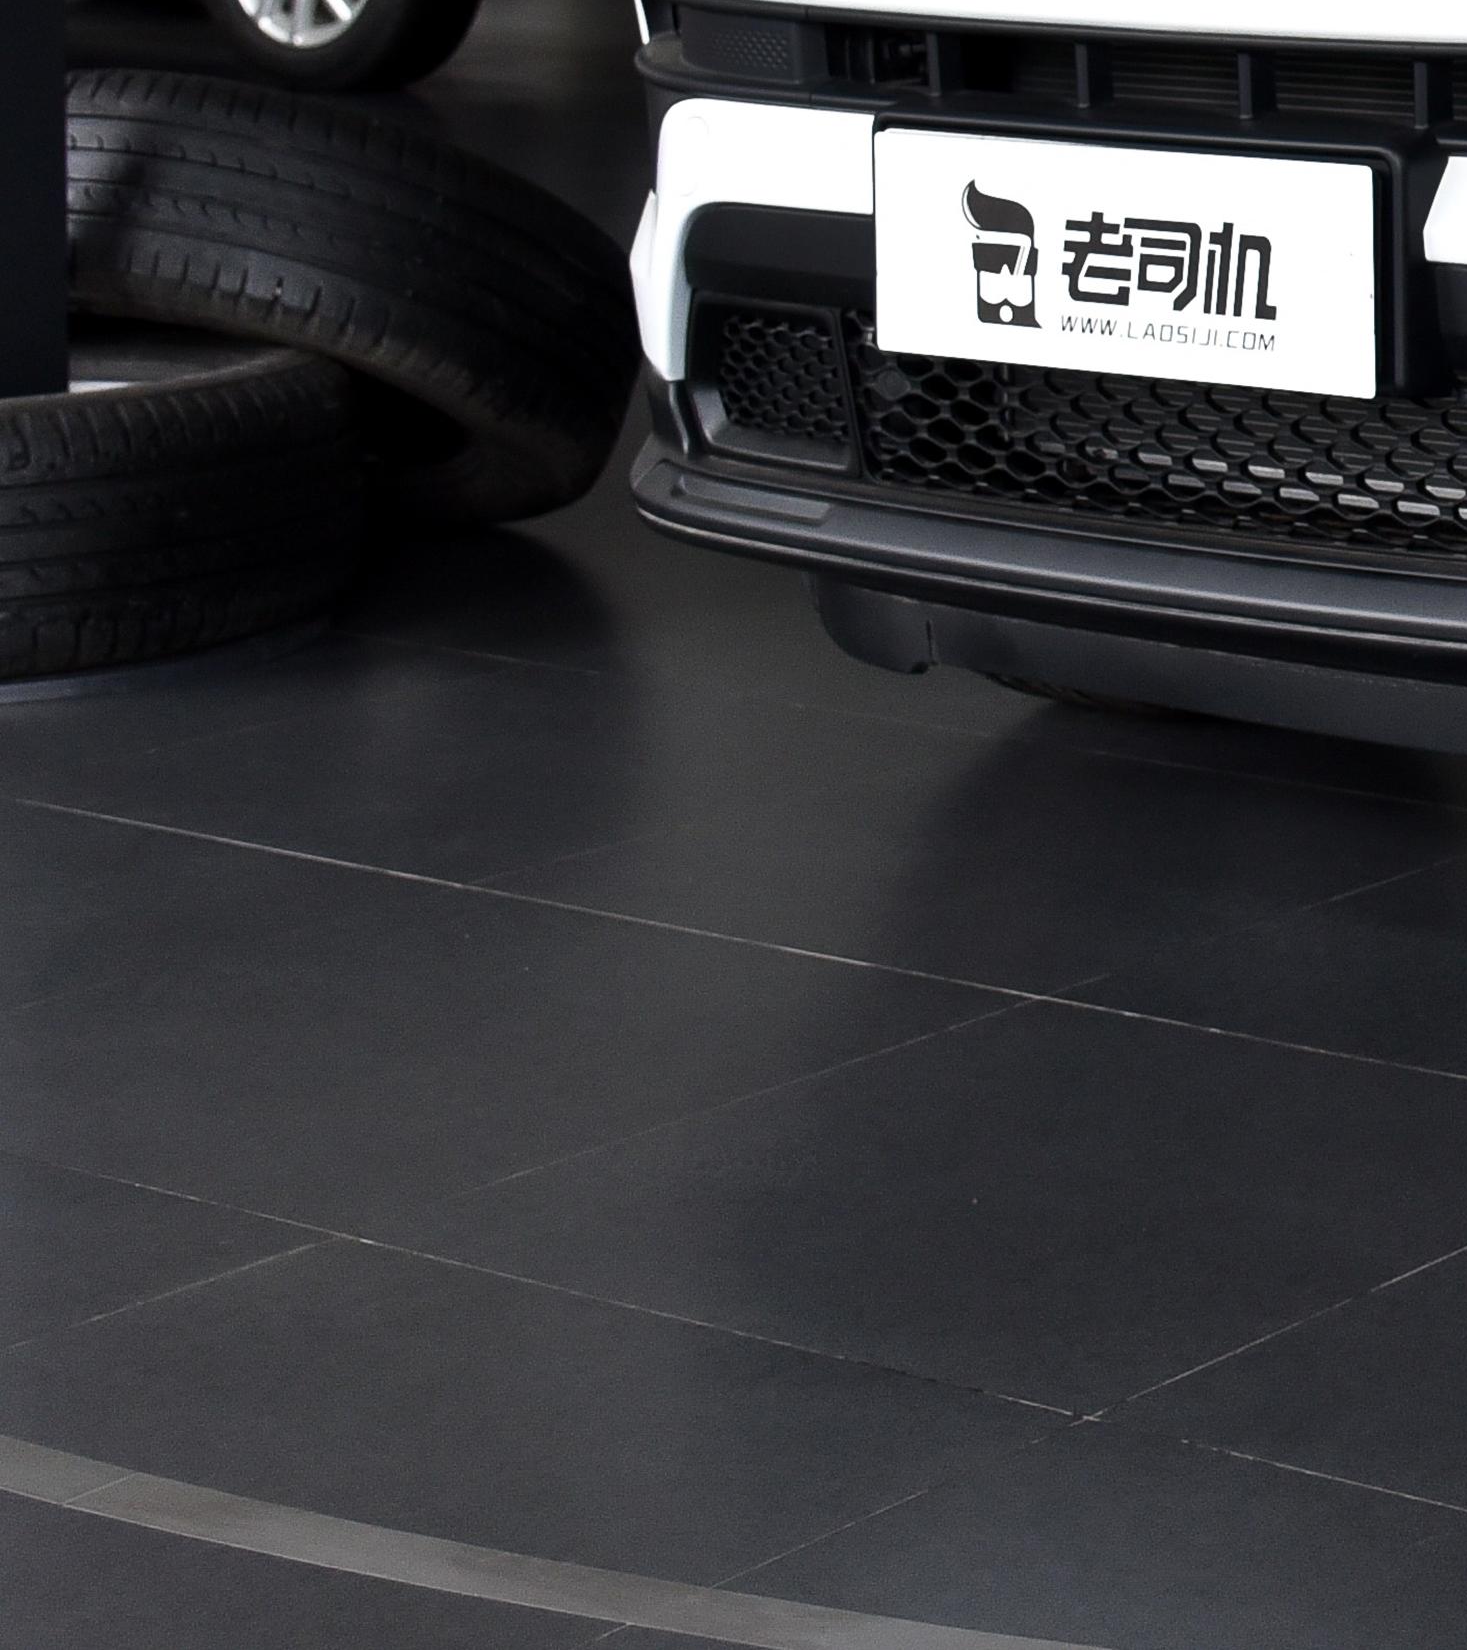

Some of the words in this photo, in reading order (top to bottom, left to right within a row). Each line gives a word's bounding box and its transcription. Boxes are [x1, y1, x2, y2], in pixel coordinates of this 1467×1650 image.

[1061, 210, 1278, 321] 老司机
[1060, 314, 1277, 352] WWW.LAOSIJI.COM
